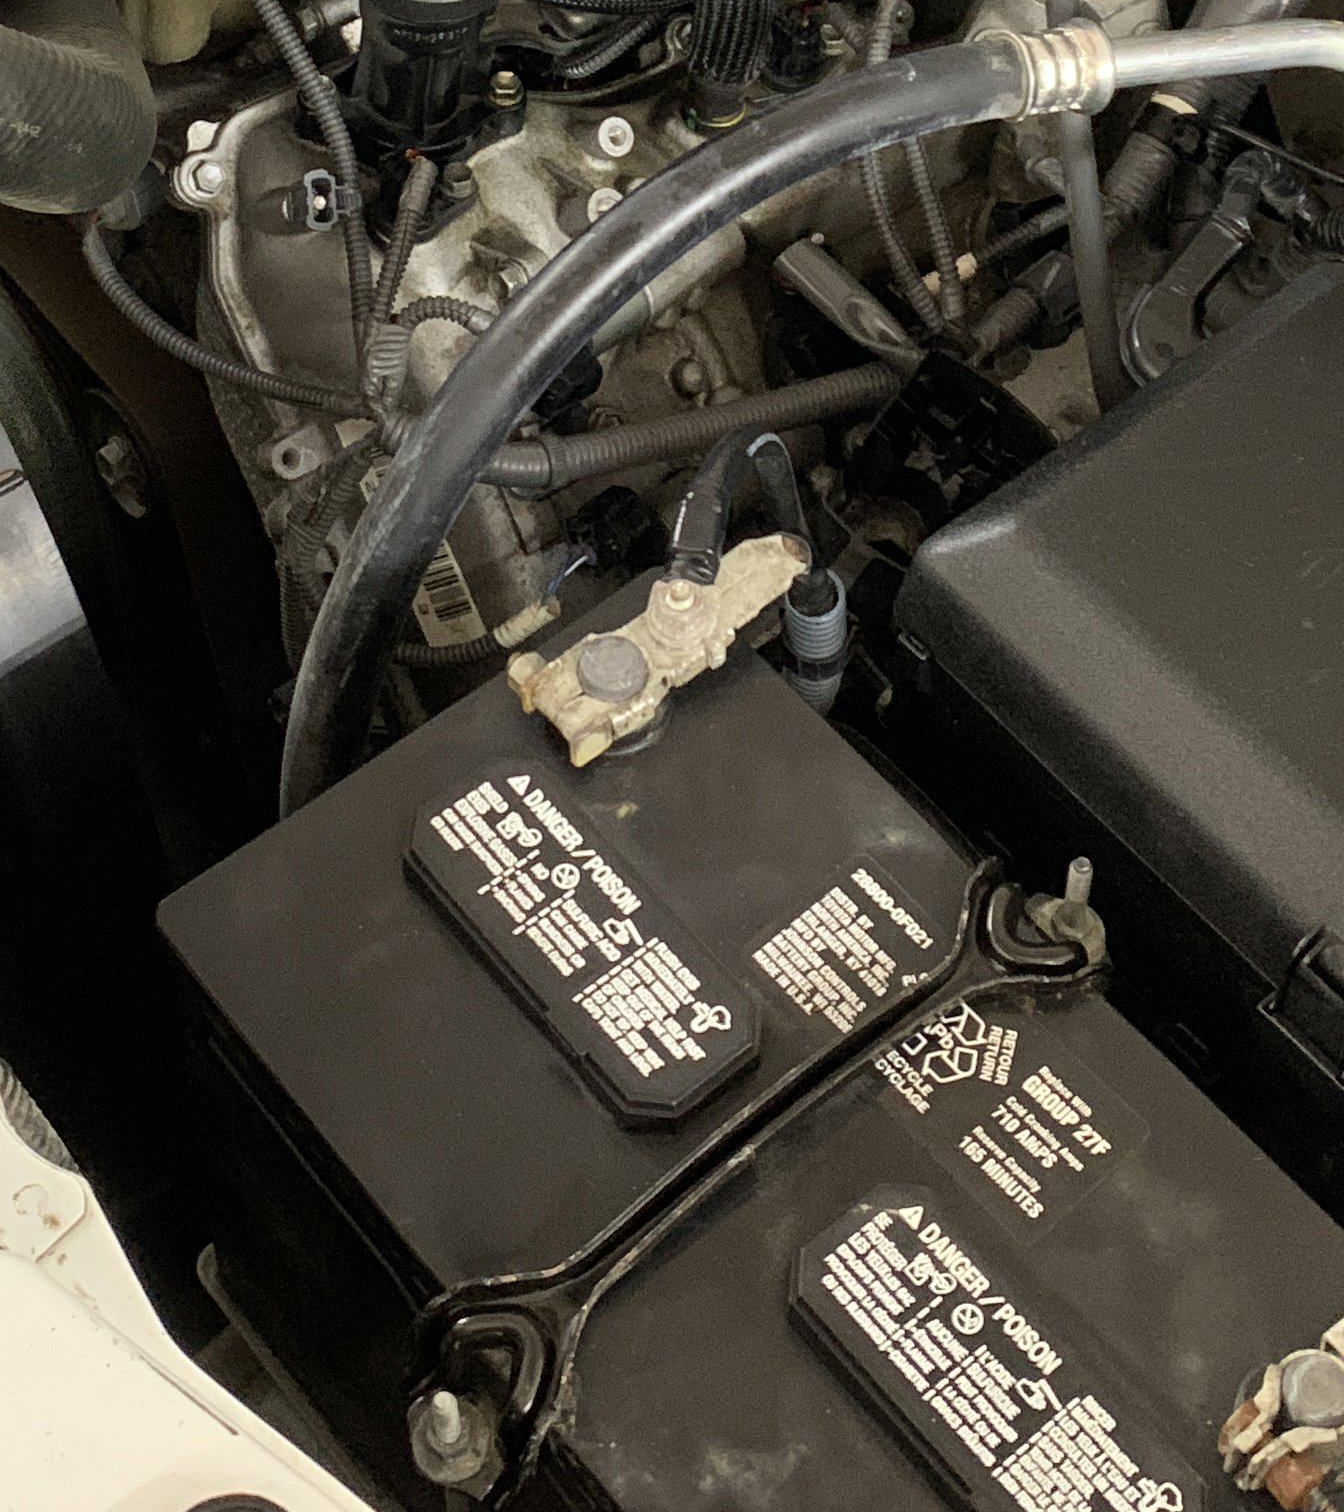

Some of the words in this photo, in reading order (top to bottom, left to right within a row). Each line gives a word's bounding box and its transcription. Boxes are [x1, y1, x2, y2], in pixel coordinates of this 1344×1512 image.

[477, 781, 509, 813] SHIELD
[529, 861, 552, 880] NO
[561, 898, 604, 942] SULFURIC
[594, 937, 621, 962] ACID
[810, 901, 840, 932] NORTH
[820, 893, 852, 927] TOYOTA
[846, 922, 879, 954] MOTOR
[828, 886, 858, 917] DISTR.
[855, 914, 874, 930] BY
[850, 868, 933, 948] 28800-0F021
[652, 941, 683, 971] FLUSH
[675, 966, 701, 991] EYES
[751, 949, 781, 977] MADE
[775, 973, 791, 988] IN
[771, 932, 811, 972] BATTERY
[780, 926, 824, 968] JOHNSON
[819, 964, 866, 1011] CONTROLS
[808, 936, 827, 951] BY
[844, 954, 862, 970] KY
[642, 950, 695, 1005] IMMEDIATELY
[811, 992, 828, 1009] WI
[661, 1016, 687, 1040] HELP
[679, 1036, 706, 1061] FAST
[932, 1023, 954, 1049] Pb
[979, 1025, 1003, 1082] RETURN
[994, 1029, 1018, 1086] RETOUR
[874, 1058, 931, 1114] CYCLAGE
[886, 1050, 934, 1097] ECYCLE
[1037, 1065, 1073, 1099] Replace
[1070, 1095, 1092, 1117] With
[990, 1103, 1020, 1132] 710
[1013, 1128, 1057, 1168] AMPS
[1004, 1095, 1028, 1117] Cold
[1023, 1113, 1061, 1150] Cranking
[1058, 1146, 1084, 1171] Amps
[1021, 1075, 1079, 1125] GROUP
[1072, 1123, 1111, 1154] 27F
[958, 1135, 987, 1162] 165
[980, 1157, 1043, 1218] MINUTES
[971, 1125, 1006, 1159] Reserve
[1003, 1156, 1041, 1193] Capacity
[847, 1231, 871, 1254] LES
[860, 1218, 907, 1271] PROTÉGER
[872, 1210, 893, 1230] SE
[924, 1318, 969, 1362] AUCUNE
[965, 1362, 1020, 1420] SULFURIQUE
[1034, 1434, 1064, 1463] SANS
[1046, 1425, 1097, 1478] CONSULTER
[1090, 1472, 1110, 1492] UN
[1057, 1415, 1080, 1436] LES
[1074, 1431, 1100, 1458] YEUX
[1122, 1485, 1142, 1503] ET
